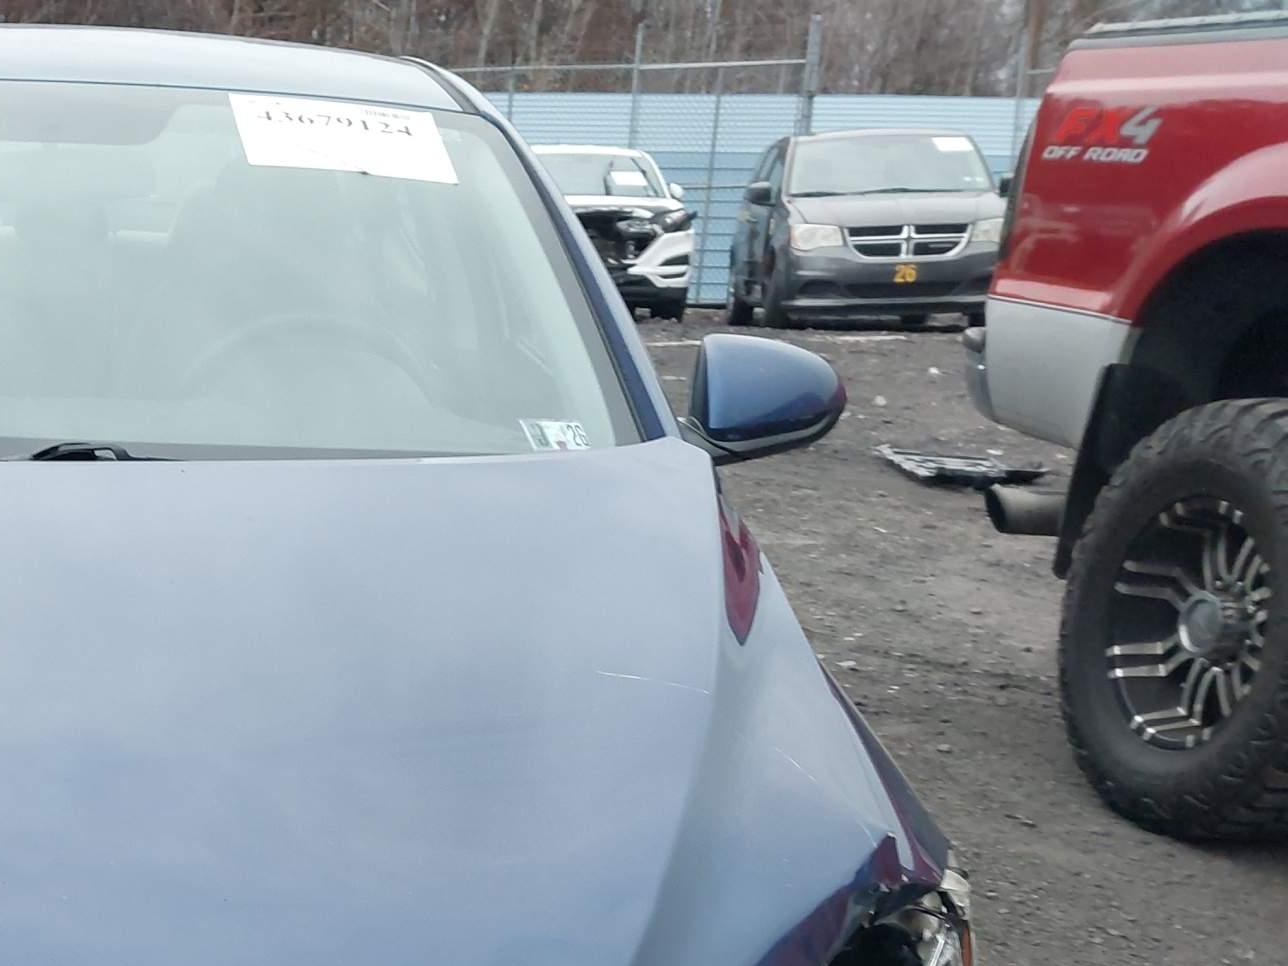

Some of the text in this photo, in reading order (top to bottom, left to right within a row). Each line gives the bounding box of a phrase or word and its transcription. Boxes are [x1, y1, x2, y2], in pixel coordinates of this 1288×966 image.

[1053, 104, 1163, 144] FX4
[1041, 145, 1149, 164] OFF ROAD
[893, 263, 918, 283] 26
